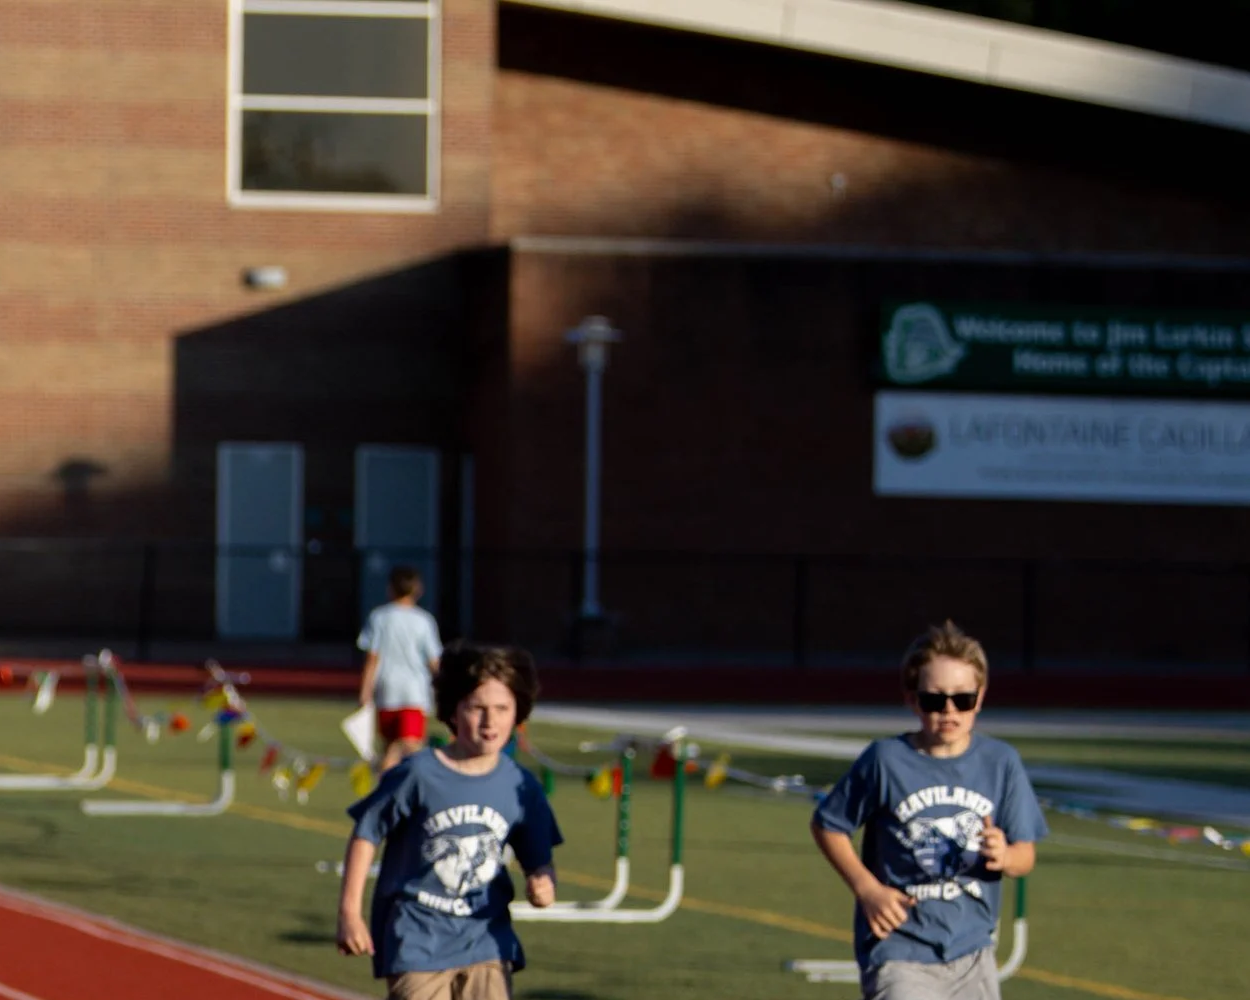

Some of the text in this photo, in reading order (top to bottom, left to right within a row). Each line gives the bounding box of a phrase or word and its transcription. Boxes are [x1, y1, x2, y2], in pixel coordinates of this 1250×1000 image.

[955, 317, 1065, 345] Welcome
[1072, 322, 1099, 346] to
[1013, 350, 1088, 375] Home
[1095, 351, 1122, 377] of
[1128, 352, 1169, 378] the
[895, 785, 994, 823] HAVILAND
